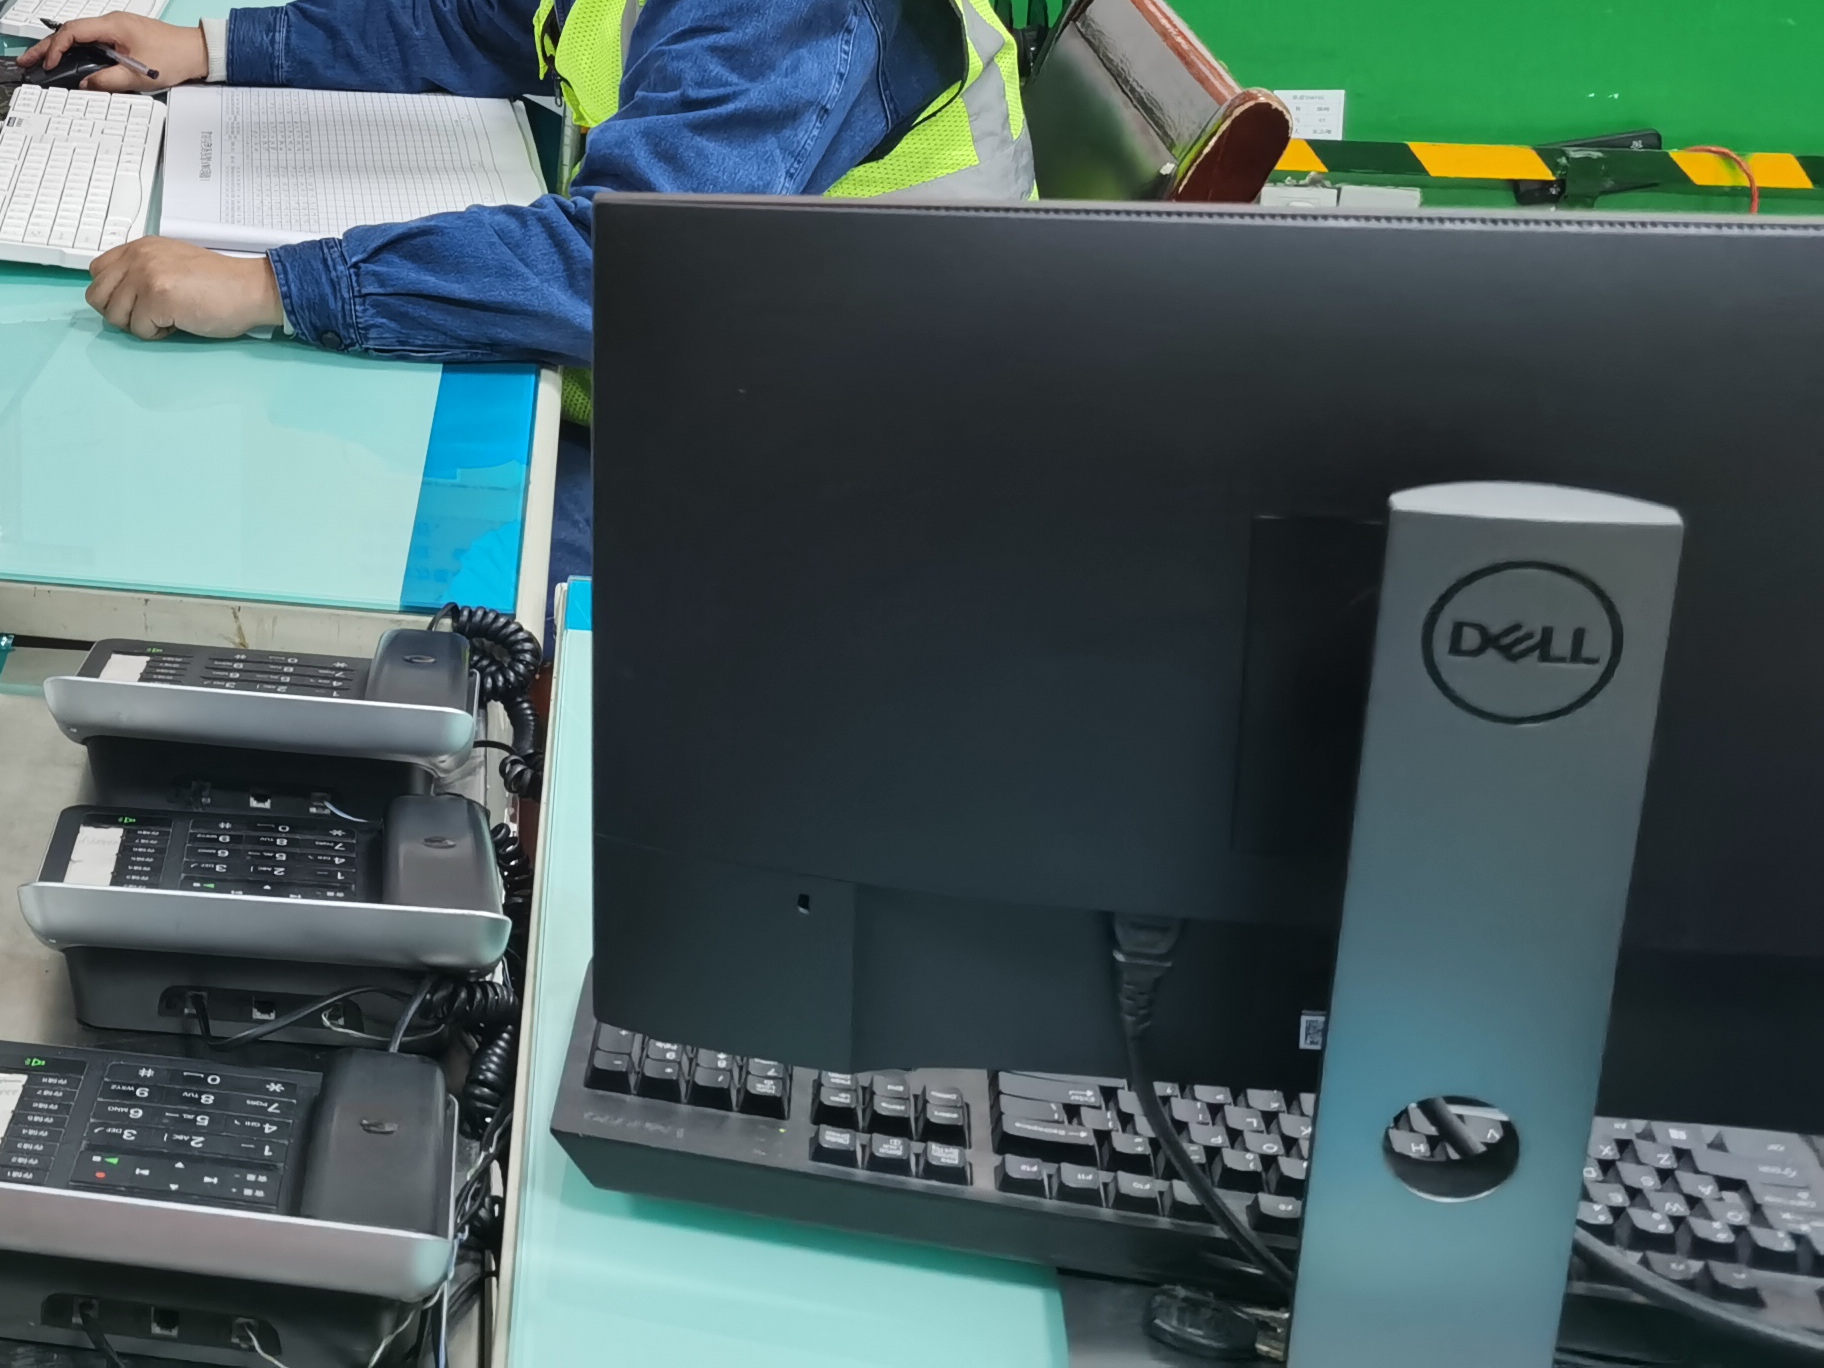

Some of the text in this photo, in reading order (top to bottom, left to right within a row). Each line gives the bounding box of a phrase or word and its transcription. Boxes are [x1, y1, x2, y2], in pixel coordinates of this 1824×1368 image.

[1447, 620, 1601, 665] DELL
[136, 1087, 150, 1098] 9
[200, 1093, 215, 1105] 8
[130, 1107, 143, 1119] 6
[268, 1102, 281, 1113] 7
[196, 1114, 209, 1126] 5
[123, 1129, 137, 1140] 3
[263, 1123, 277, 1134] 4
[190, 1135, 205, 1147] 2
